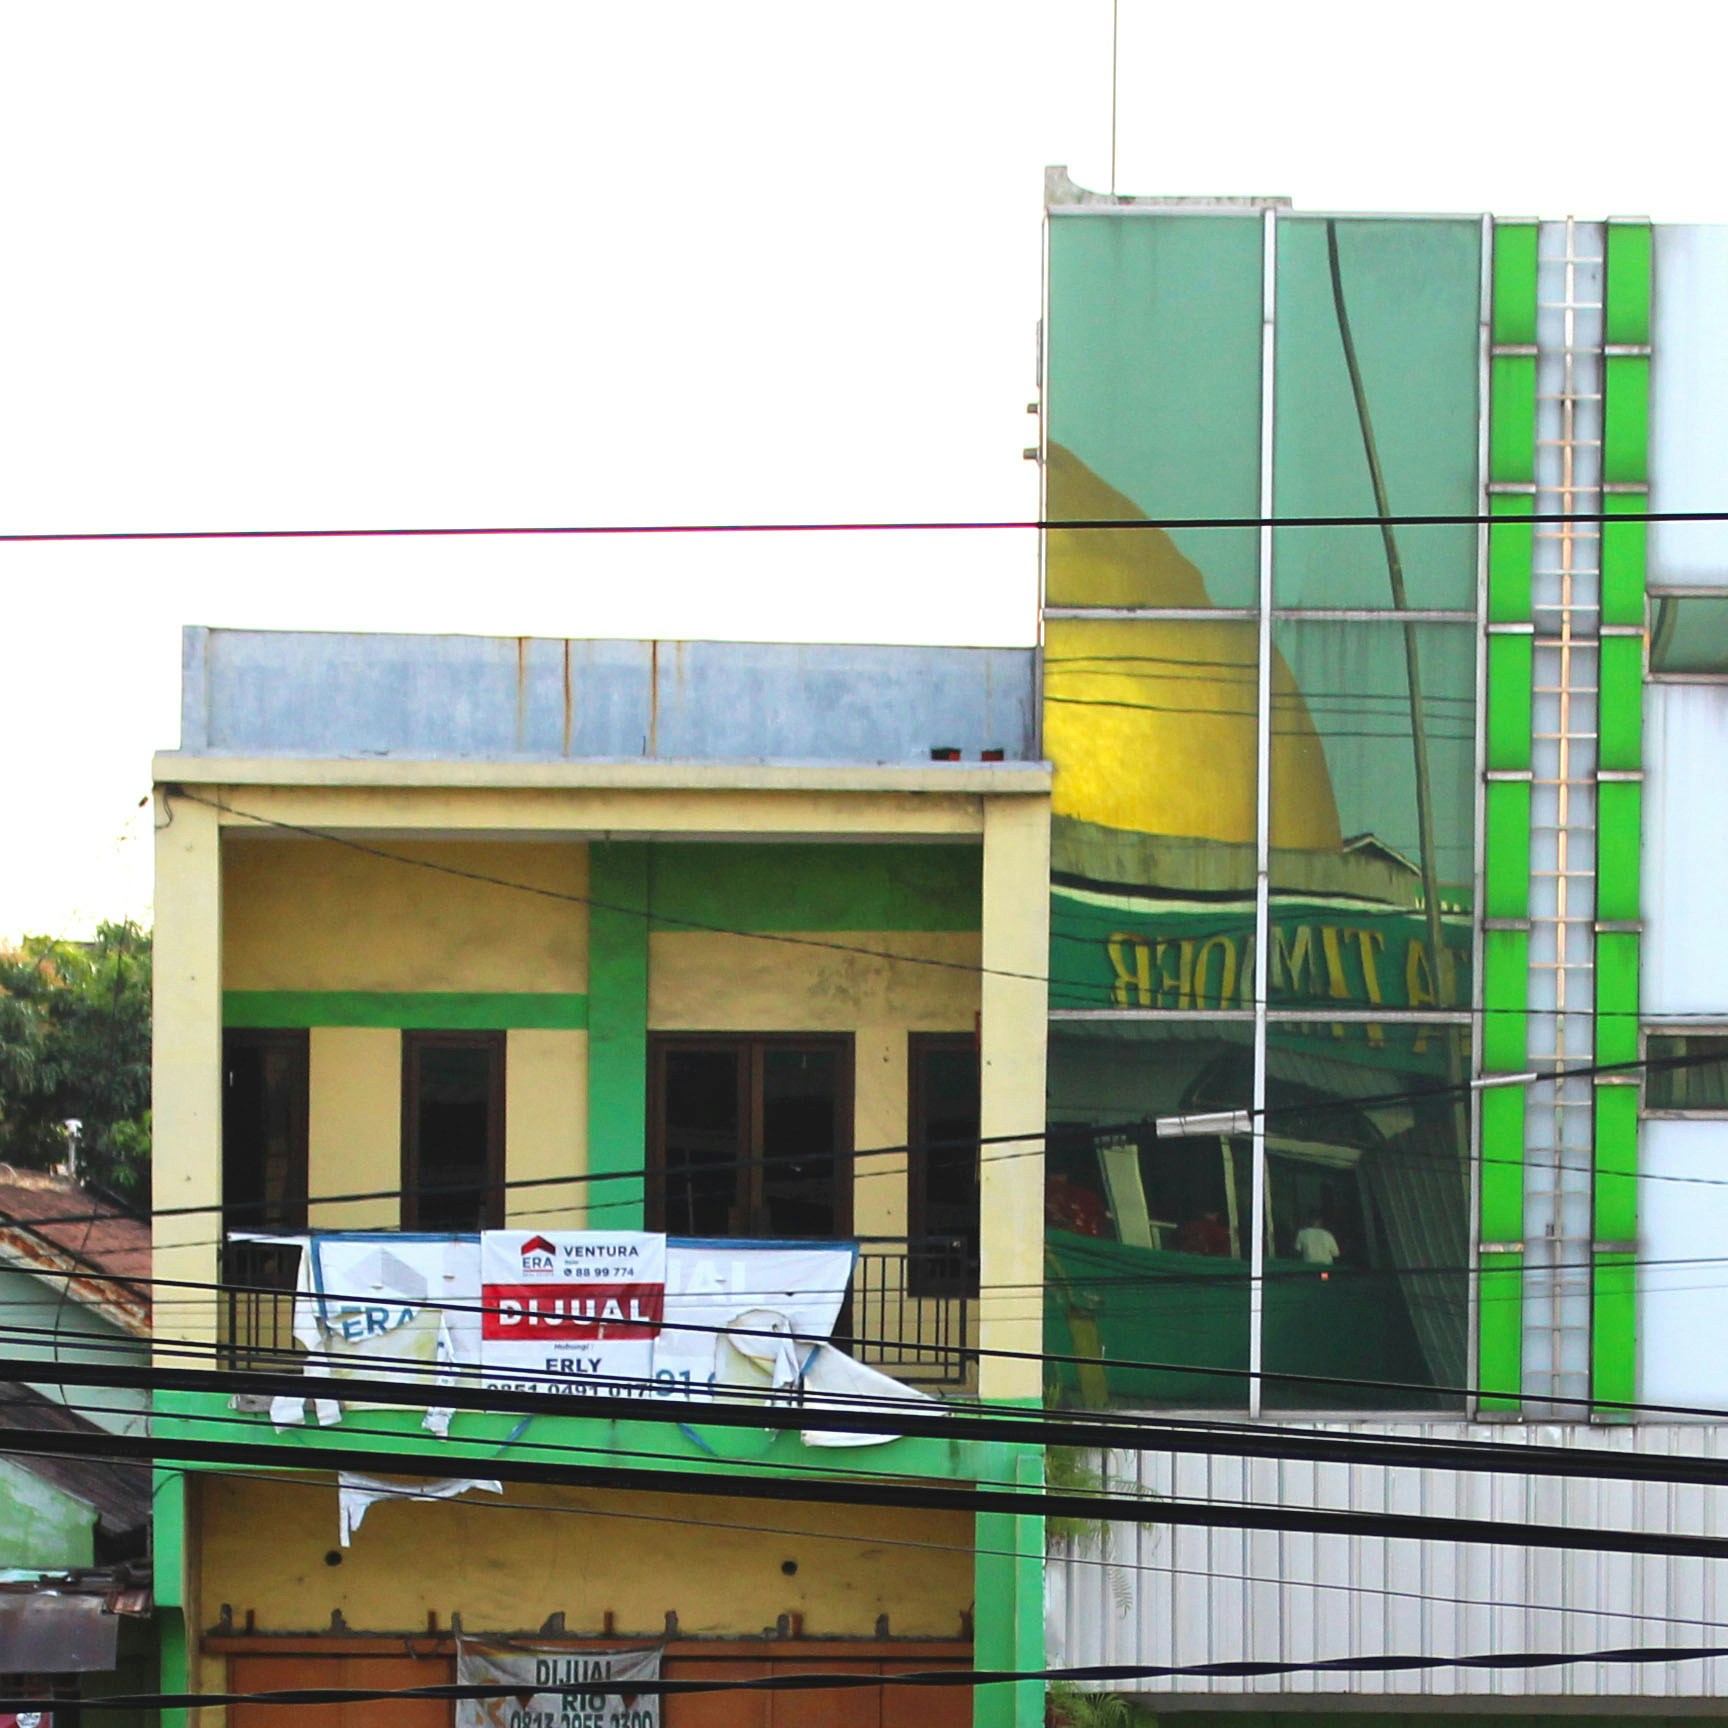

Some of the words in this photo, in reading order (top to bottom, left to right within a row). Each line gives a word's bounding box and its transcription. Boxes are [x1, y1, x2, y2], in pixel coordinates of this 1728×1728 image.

[563, 1245, 639, 1257] VENTURA
[522, 1257, 554, 1269] ERA
[576, 1268, 591, 1277] 88
[594, 1268, 610, 1277] 99
[614, 1268, 635, 1277] 774
[498, 1298, 651, 1326] DIJUAL
[545, 1358, 602, 1373] ERLY
[561, 1693, 607, 1712] RIO
